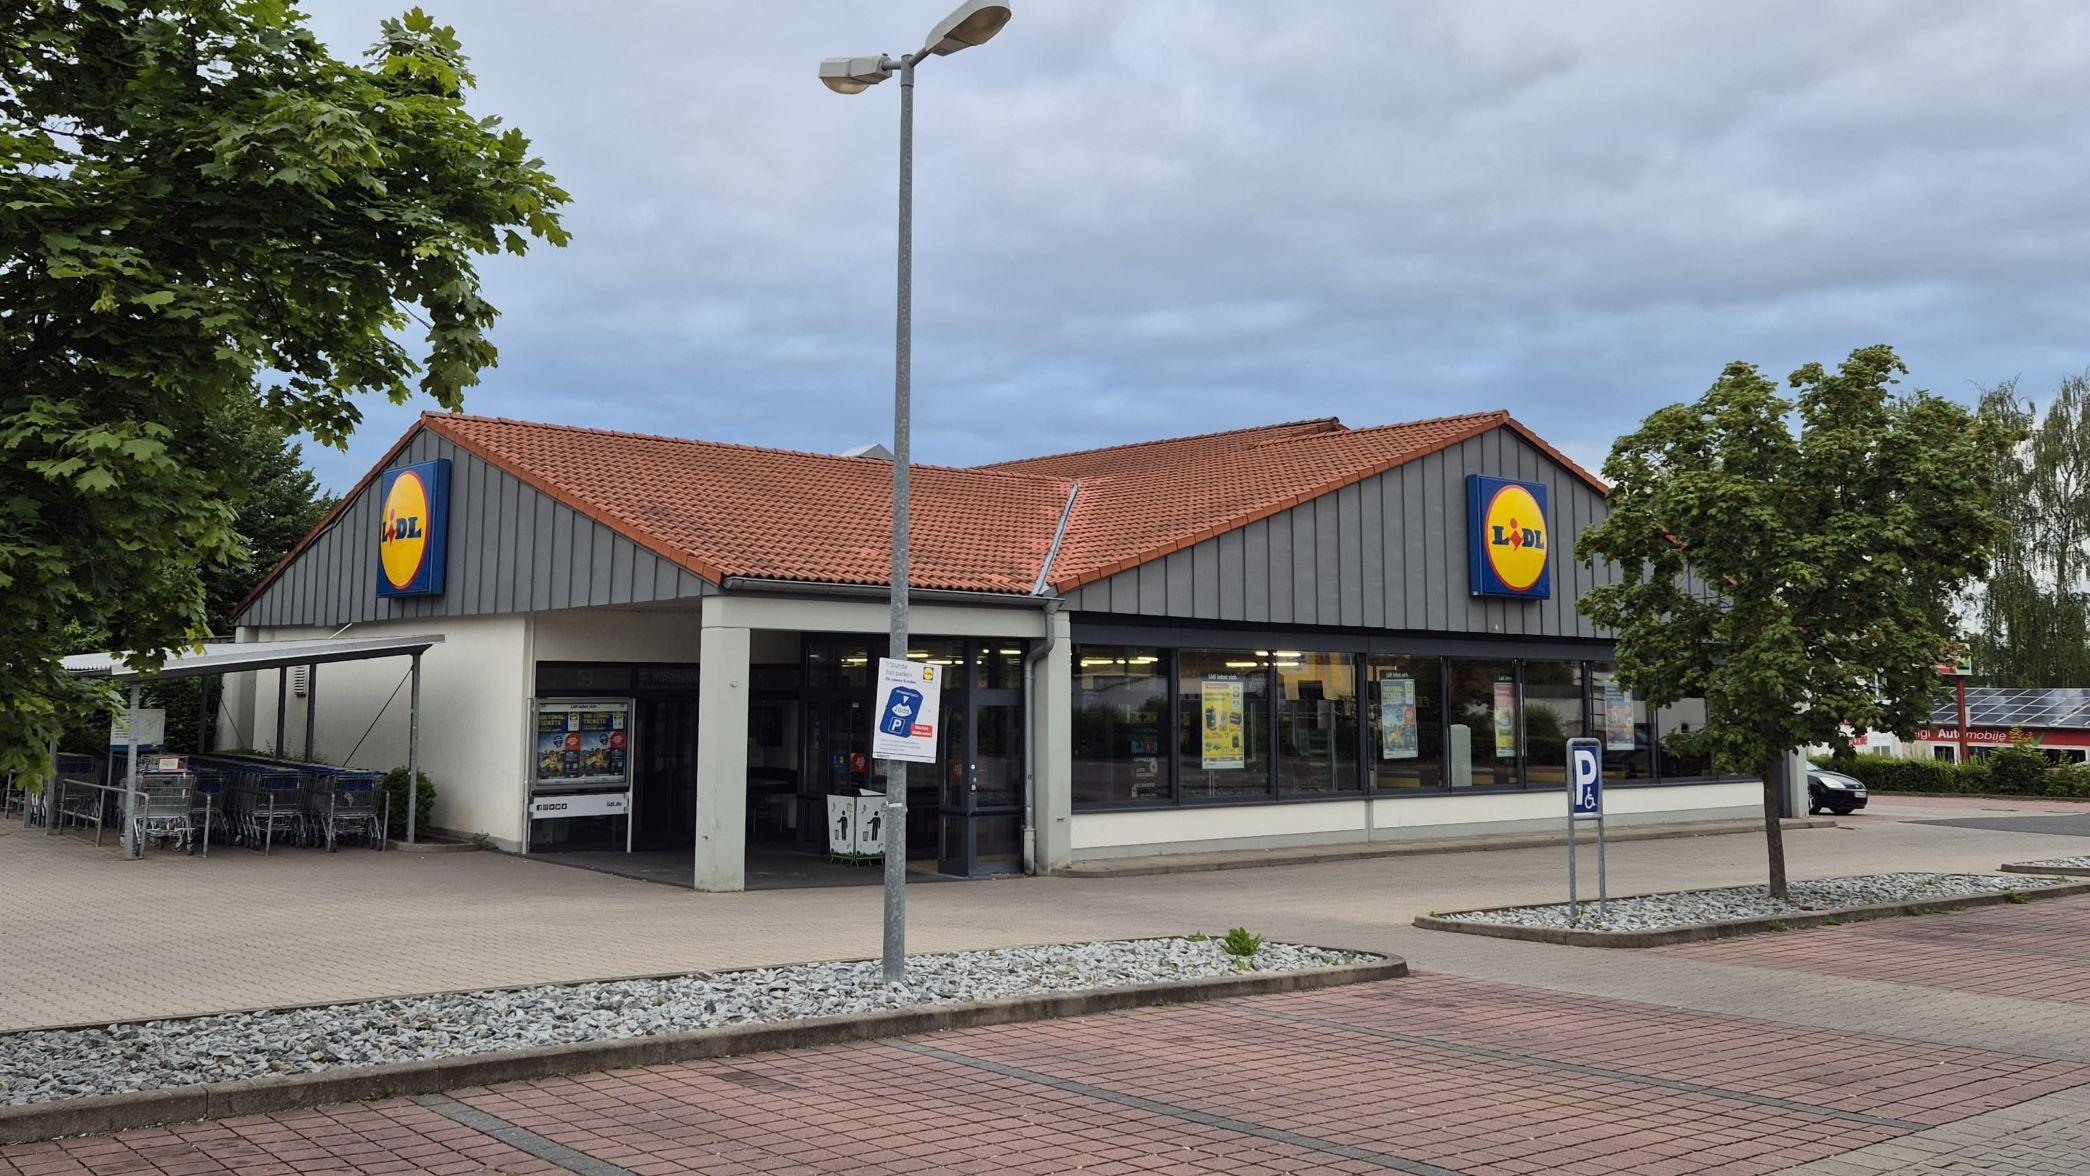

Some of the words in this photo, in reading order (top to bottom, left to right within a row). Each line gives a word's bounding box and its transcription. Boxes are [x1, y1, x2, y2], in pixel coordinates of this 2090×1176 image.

[892, 719, 902, 731] P
[1938, 728, 2007, 741] Autmobile
[1574, 750, 1597, 806] P
